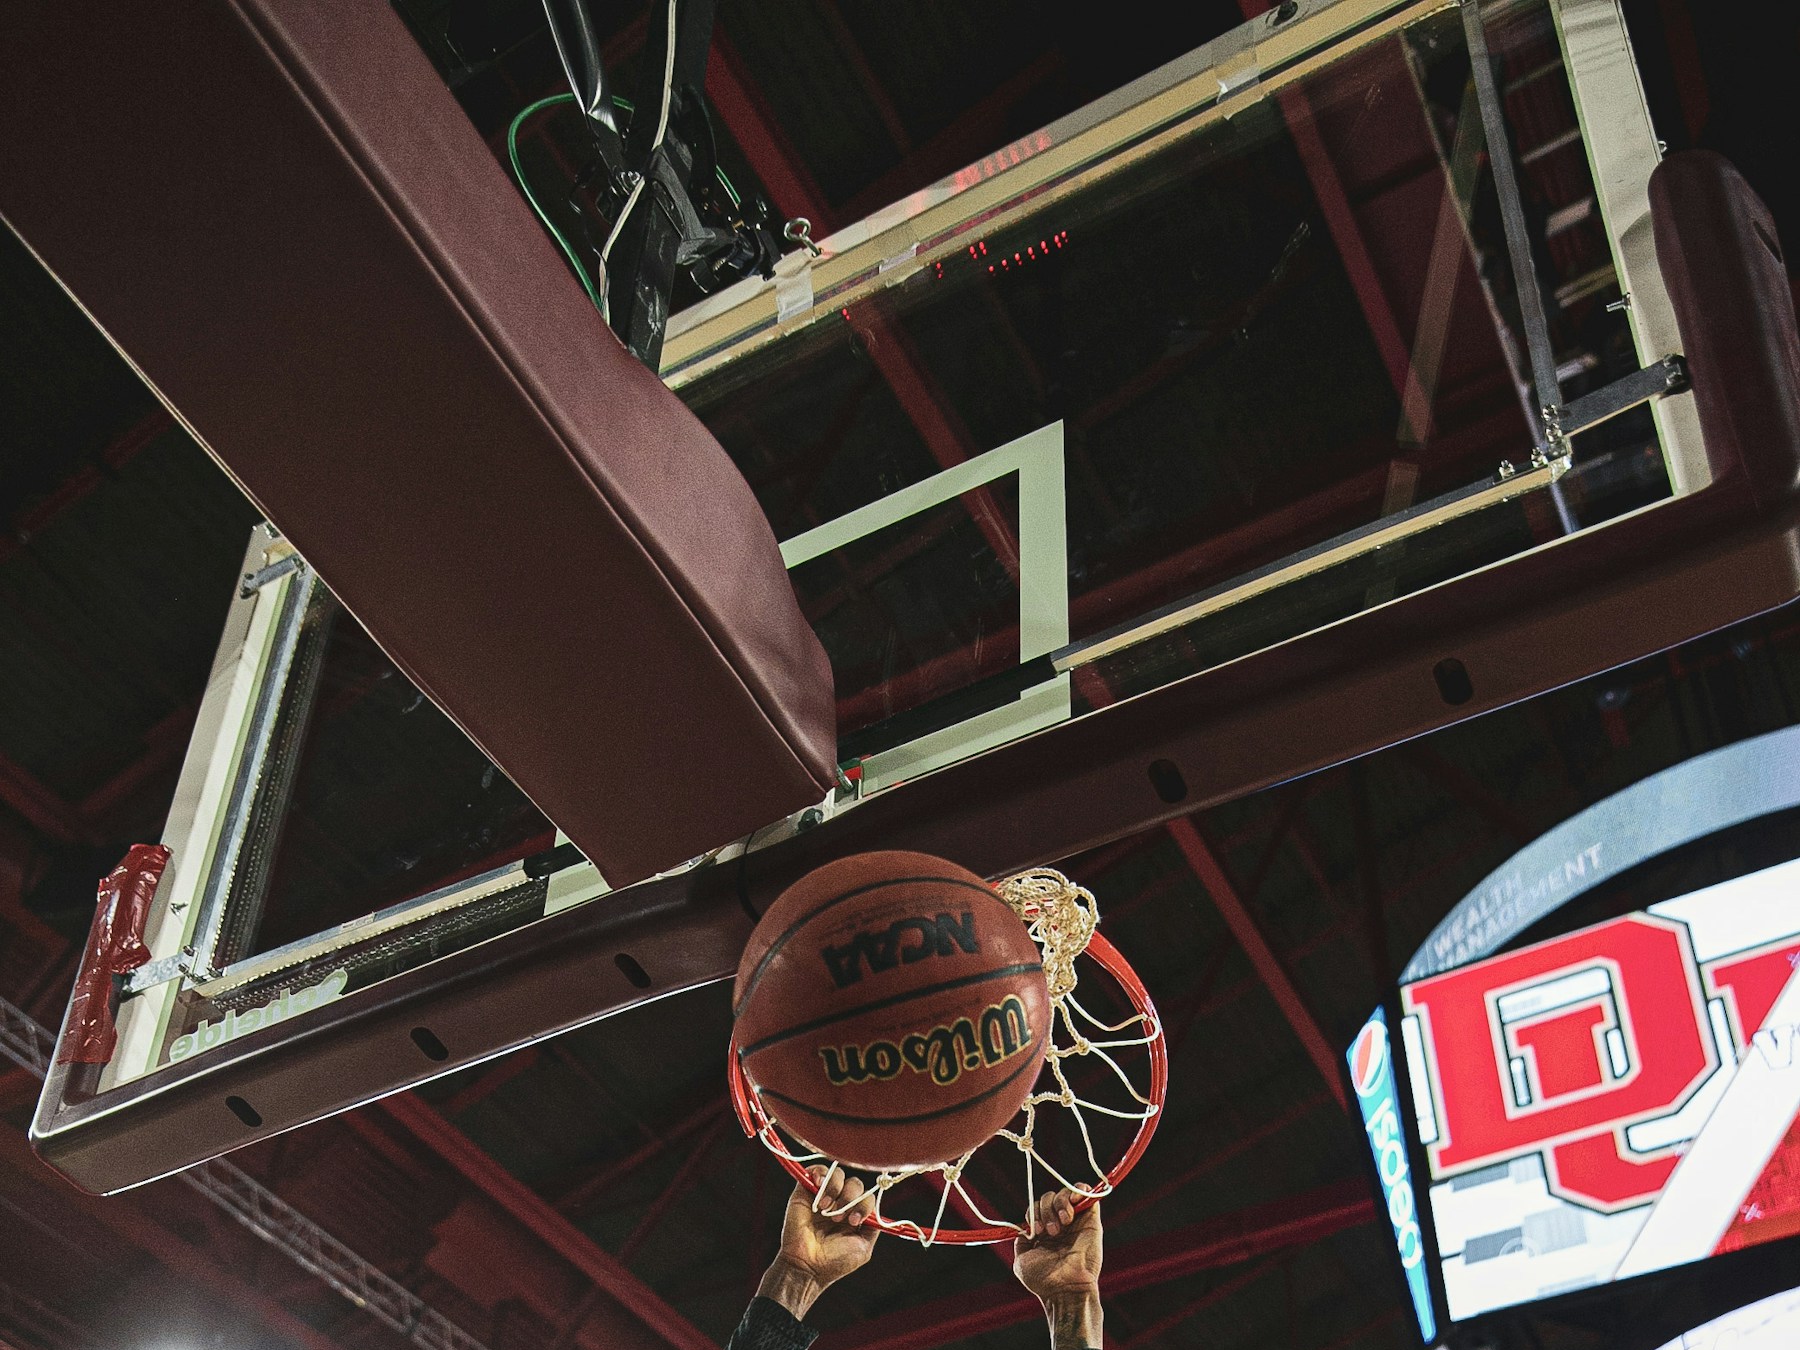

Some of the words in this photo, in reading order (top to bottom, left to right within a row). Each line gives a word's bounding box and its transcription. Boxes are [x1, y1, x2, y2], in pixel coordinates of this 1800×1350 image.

[822, 912, 983, 989] NCAA
[1433, 871, 1522, 960] WEALTH
[818, 994, 1033, 1086] Wilson
